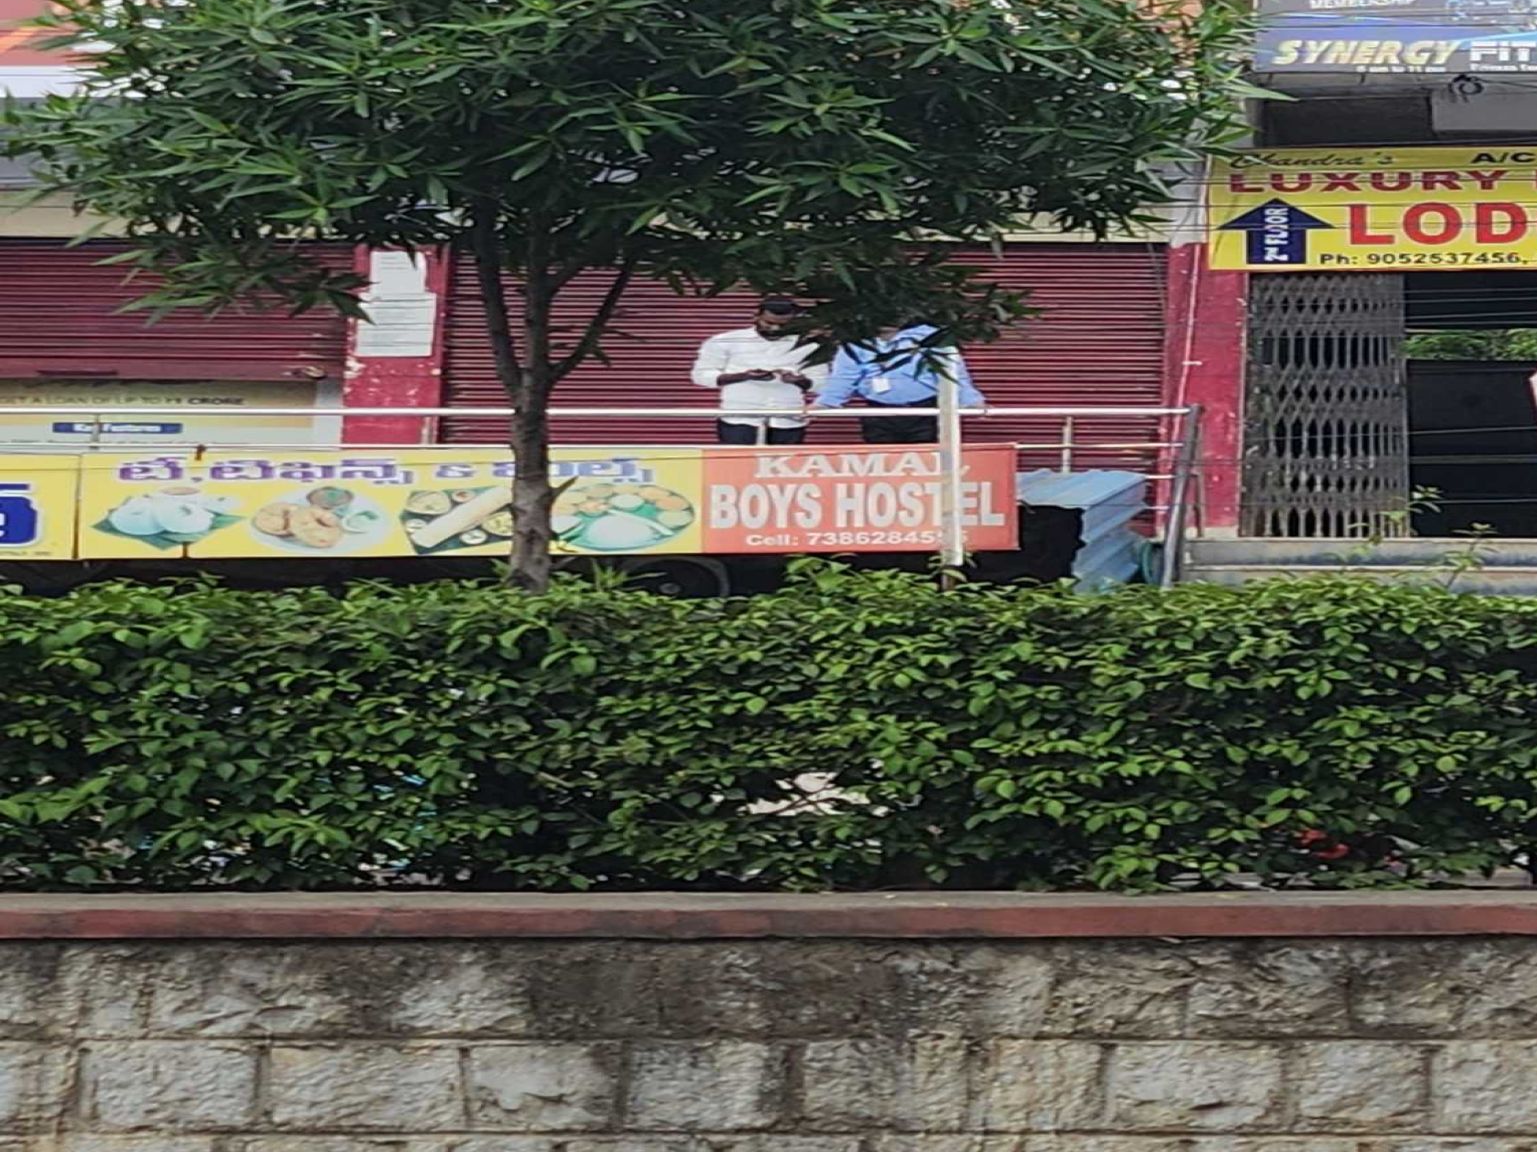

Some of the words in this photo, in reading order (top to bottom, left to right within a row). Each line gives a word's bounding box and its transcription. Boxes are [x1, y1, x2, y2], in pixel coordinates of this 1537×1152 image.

[1272, 39, 1460, 66] SYNERGY
[1471, 150, 1537, 165] A/C
[1229, 169, 1499, 194] LUXURY
[1263, 207, 1290, 246] FLOOR
[1319, 253, 1358, 265] Ph:
[709, 482, 825, 530] BOYS
[834, 481, 1005, 529] HOSTEL
[745, 533, 800, 547] Cell:
[805, 530, 969, 547] 73862845
